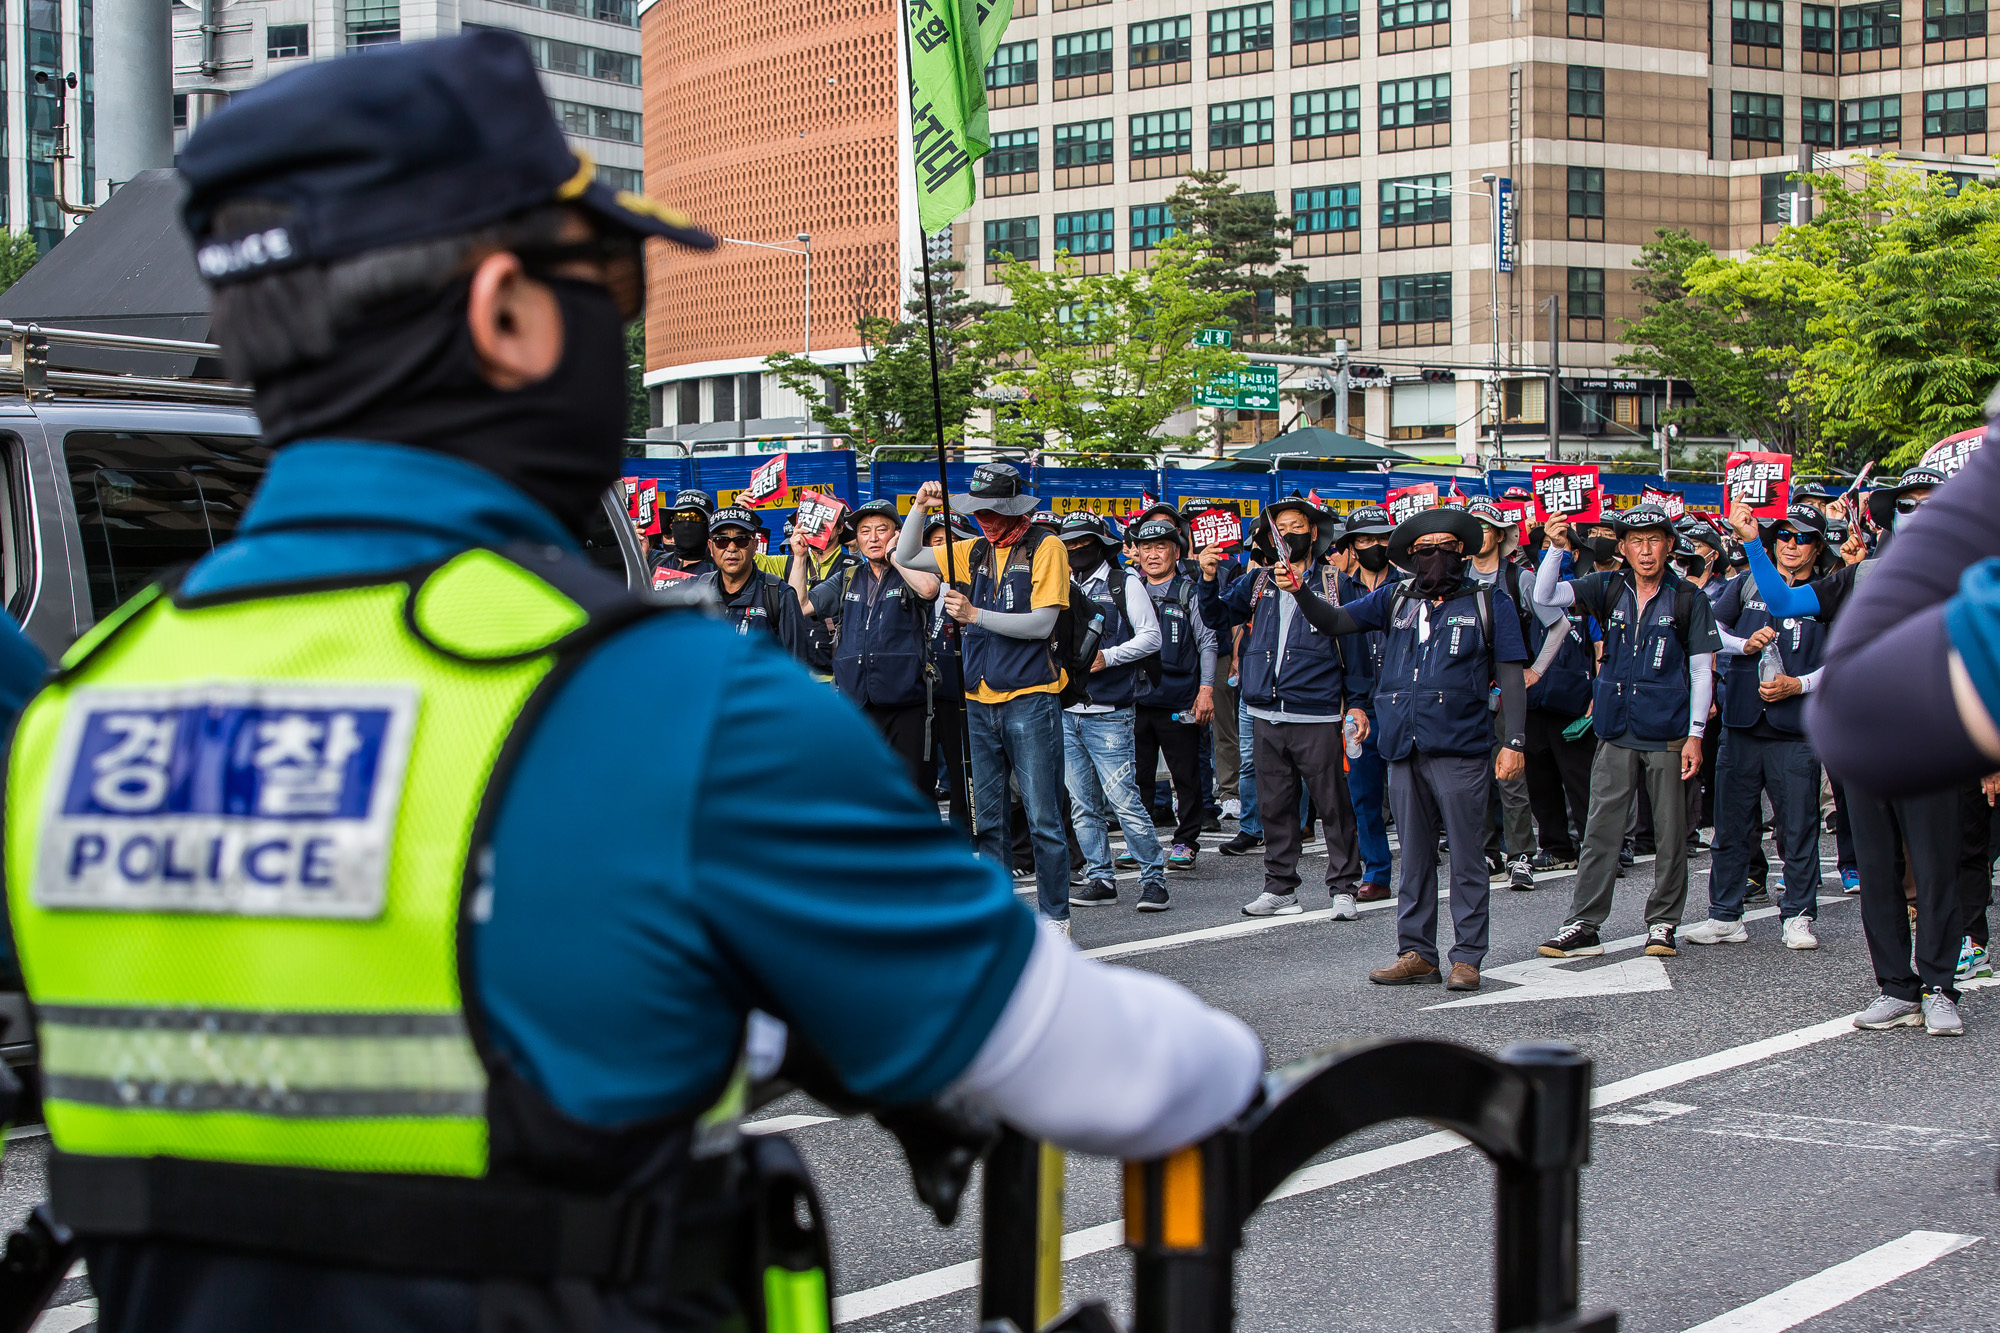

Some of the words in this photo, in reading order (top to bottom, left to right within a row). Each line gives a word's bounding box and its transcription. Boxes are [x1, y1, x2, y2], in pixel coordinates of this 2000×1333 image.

[1202, 331, 1225, 344] 시청
[1239, 373, 1276, 385] 을지로1가
[1955, 434, 1983, 456] 정권
[1535, 476, 1565, 495] 윤석열
[1567, 474, 1594, 490] 정권
[1726, 464, 1752, 485] 윤석열
[1754, 463, 1784, 480] 정권
[752, 474, 778, 500] 퇴진!
[1731, 480, 1767, 503] 퇴진!
[814, 503, 837, 521] 정권
[1388, 497, 1411, 514] 윤석열
[1412, 492, 1435, 506] 정권
[1544, 489, 1583, 514] 퇴진!
[640, 505, 652, 526] 진!
[1196, 511, 1234, 530] 건설노조
[1193, 528, 1217, 548] 탄압
[1217, 522, 1242, 543] 분쇄!
[92, 714, 364, 814] 경찰
[67, 834, 338, 888] POLICE
